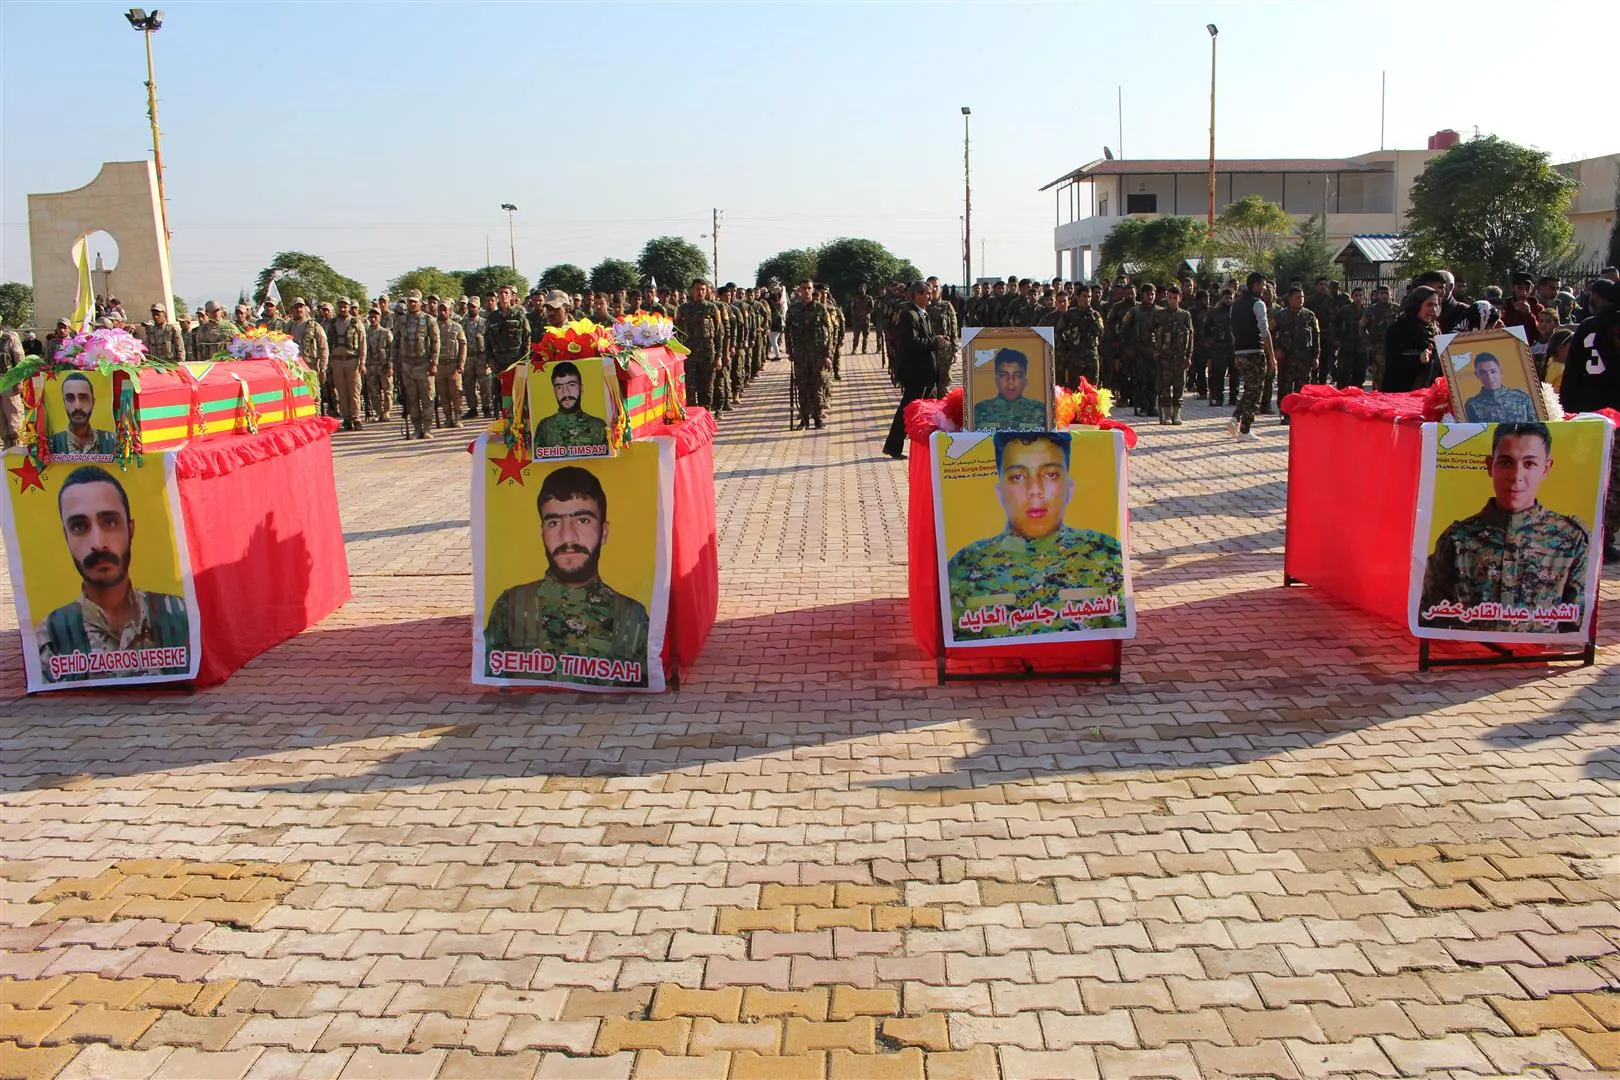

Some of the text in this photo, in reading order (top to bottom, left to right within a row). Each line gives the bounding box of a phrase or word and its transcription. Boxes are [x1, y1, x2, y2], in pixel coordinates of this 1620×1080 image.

[1584, 333, 1605, 374] 3
[537, 445, 606, 457] ŞEHÎD TIMSAH
[960, 597, 1118, 630] الشهيد جاسم العايد
[1534, 605, 1579, 625] الشهيد
[50, 648, 186, 678] ŞEHÎD ZAGROS HESEKE
[490, 649, 641, 681] ŞEHÎD TIMSAH
